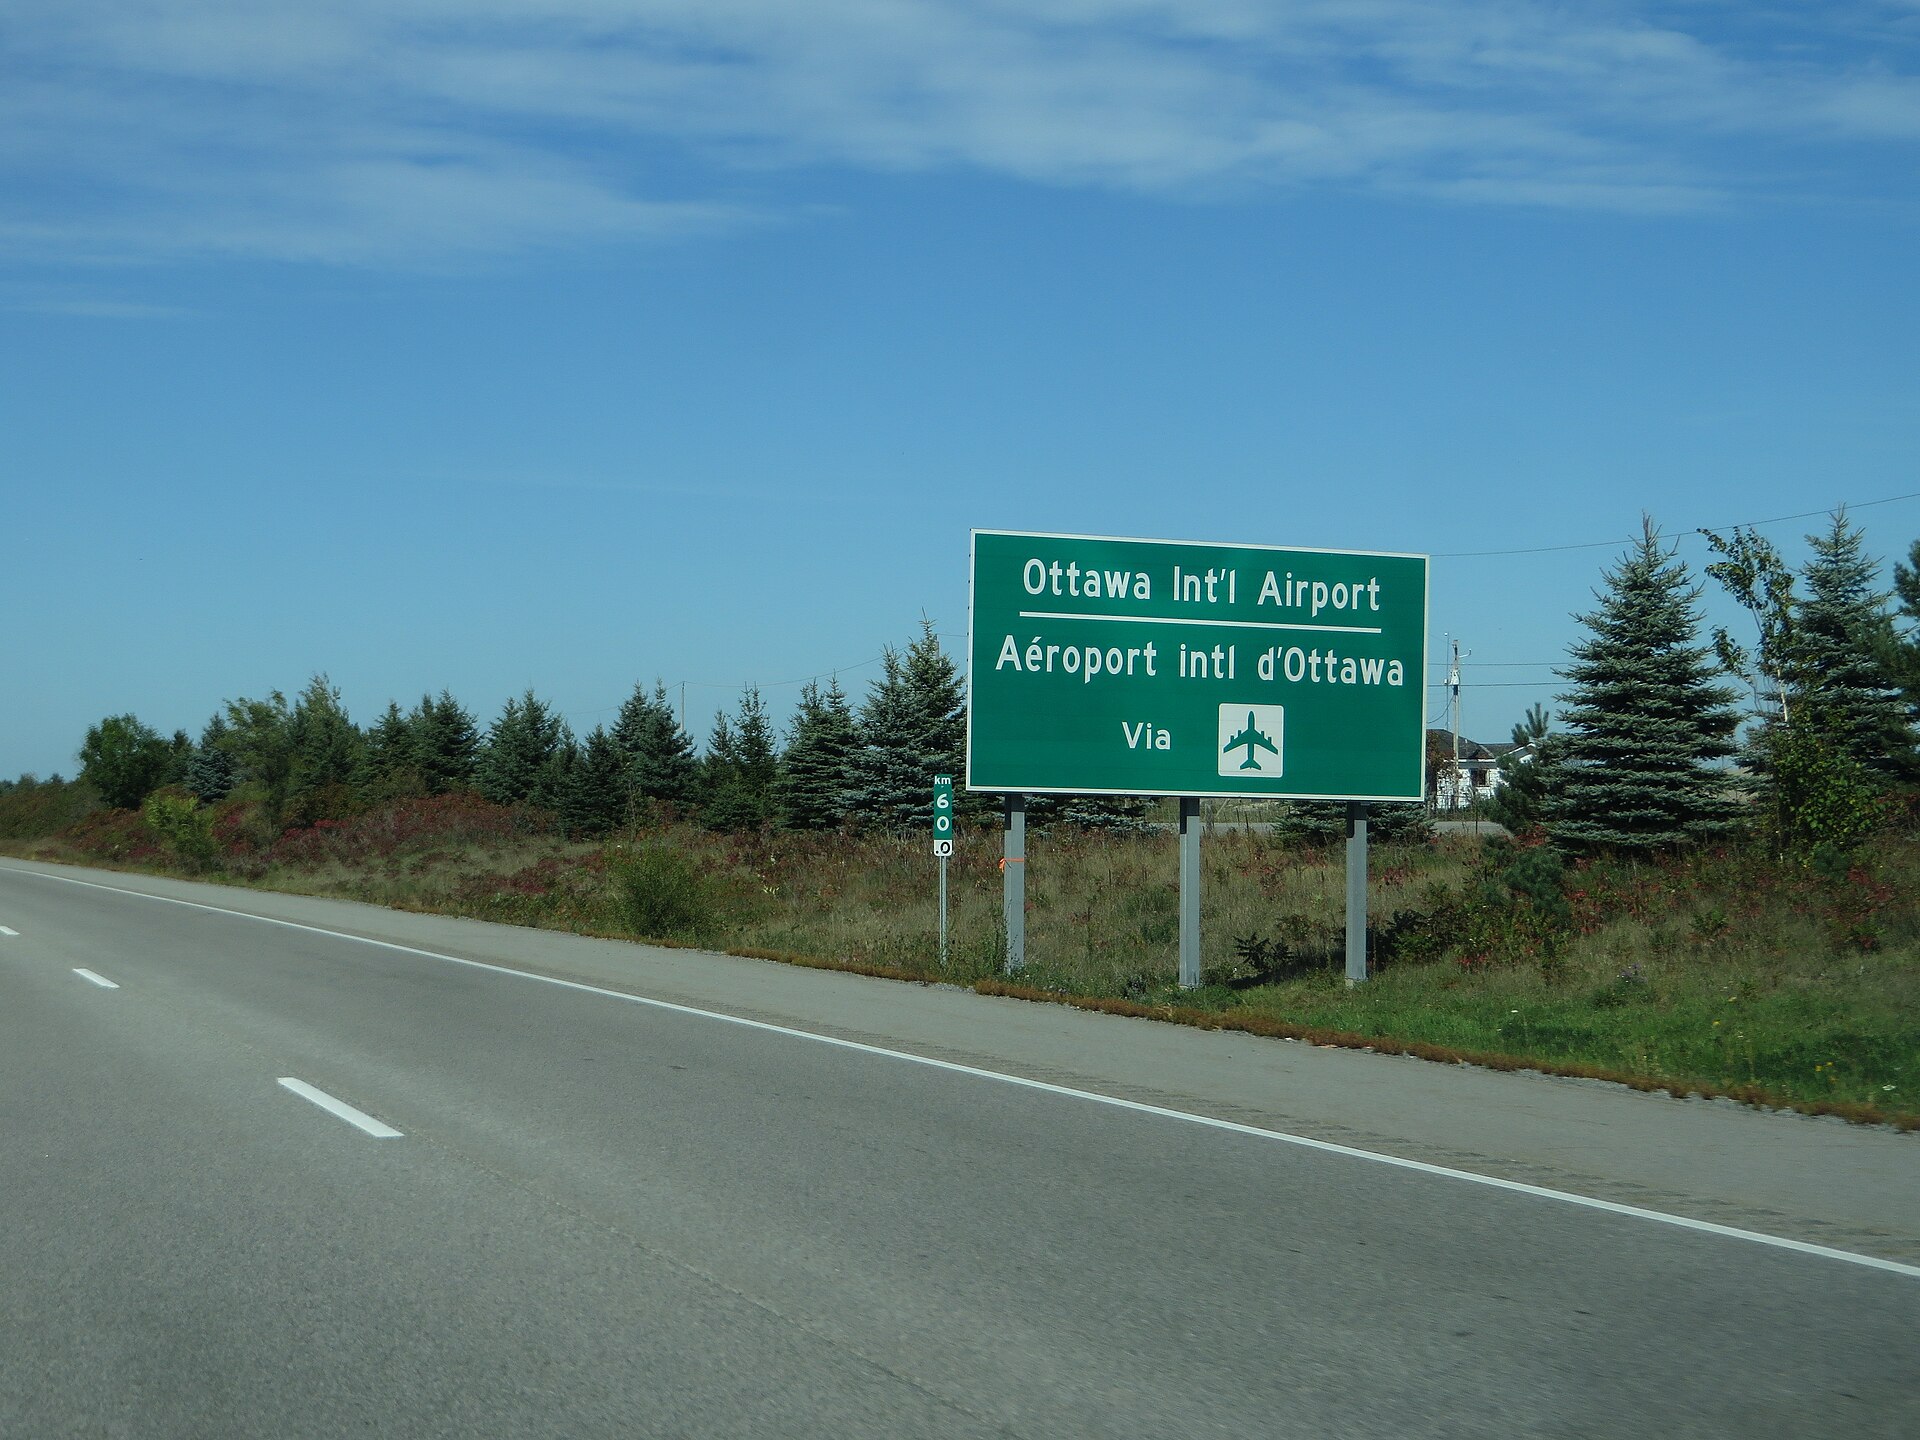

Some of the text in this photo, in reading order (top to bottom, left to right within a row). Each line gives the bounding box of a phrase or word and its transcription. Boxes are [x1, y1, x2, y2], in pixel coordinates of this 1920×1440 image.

[1024, 558, 1380, 617] Ottawa Int'l Airport
[995, 635, 1404, 686] Aéroport intl d'Ottawa
[1122, 721, 1171, 750] Via
[934, 775, 951, 785] km
